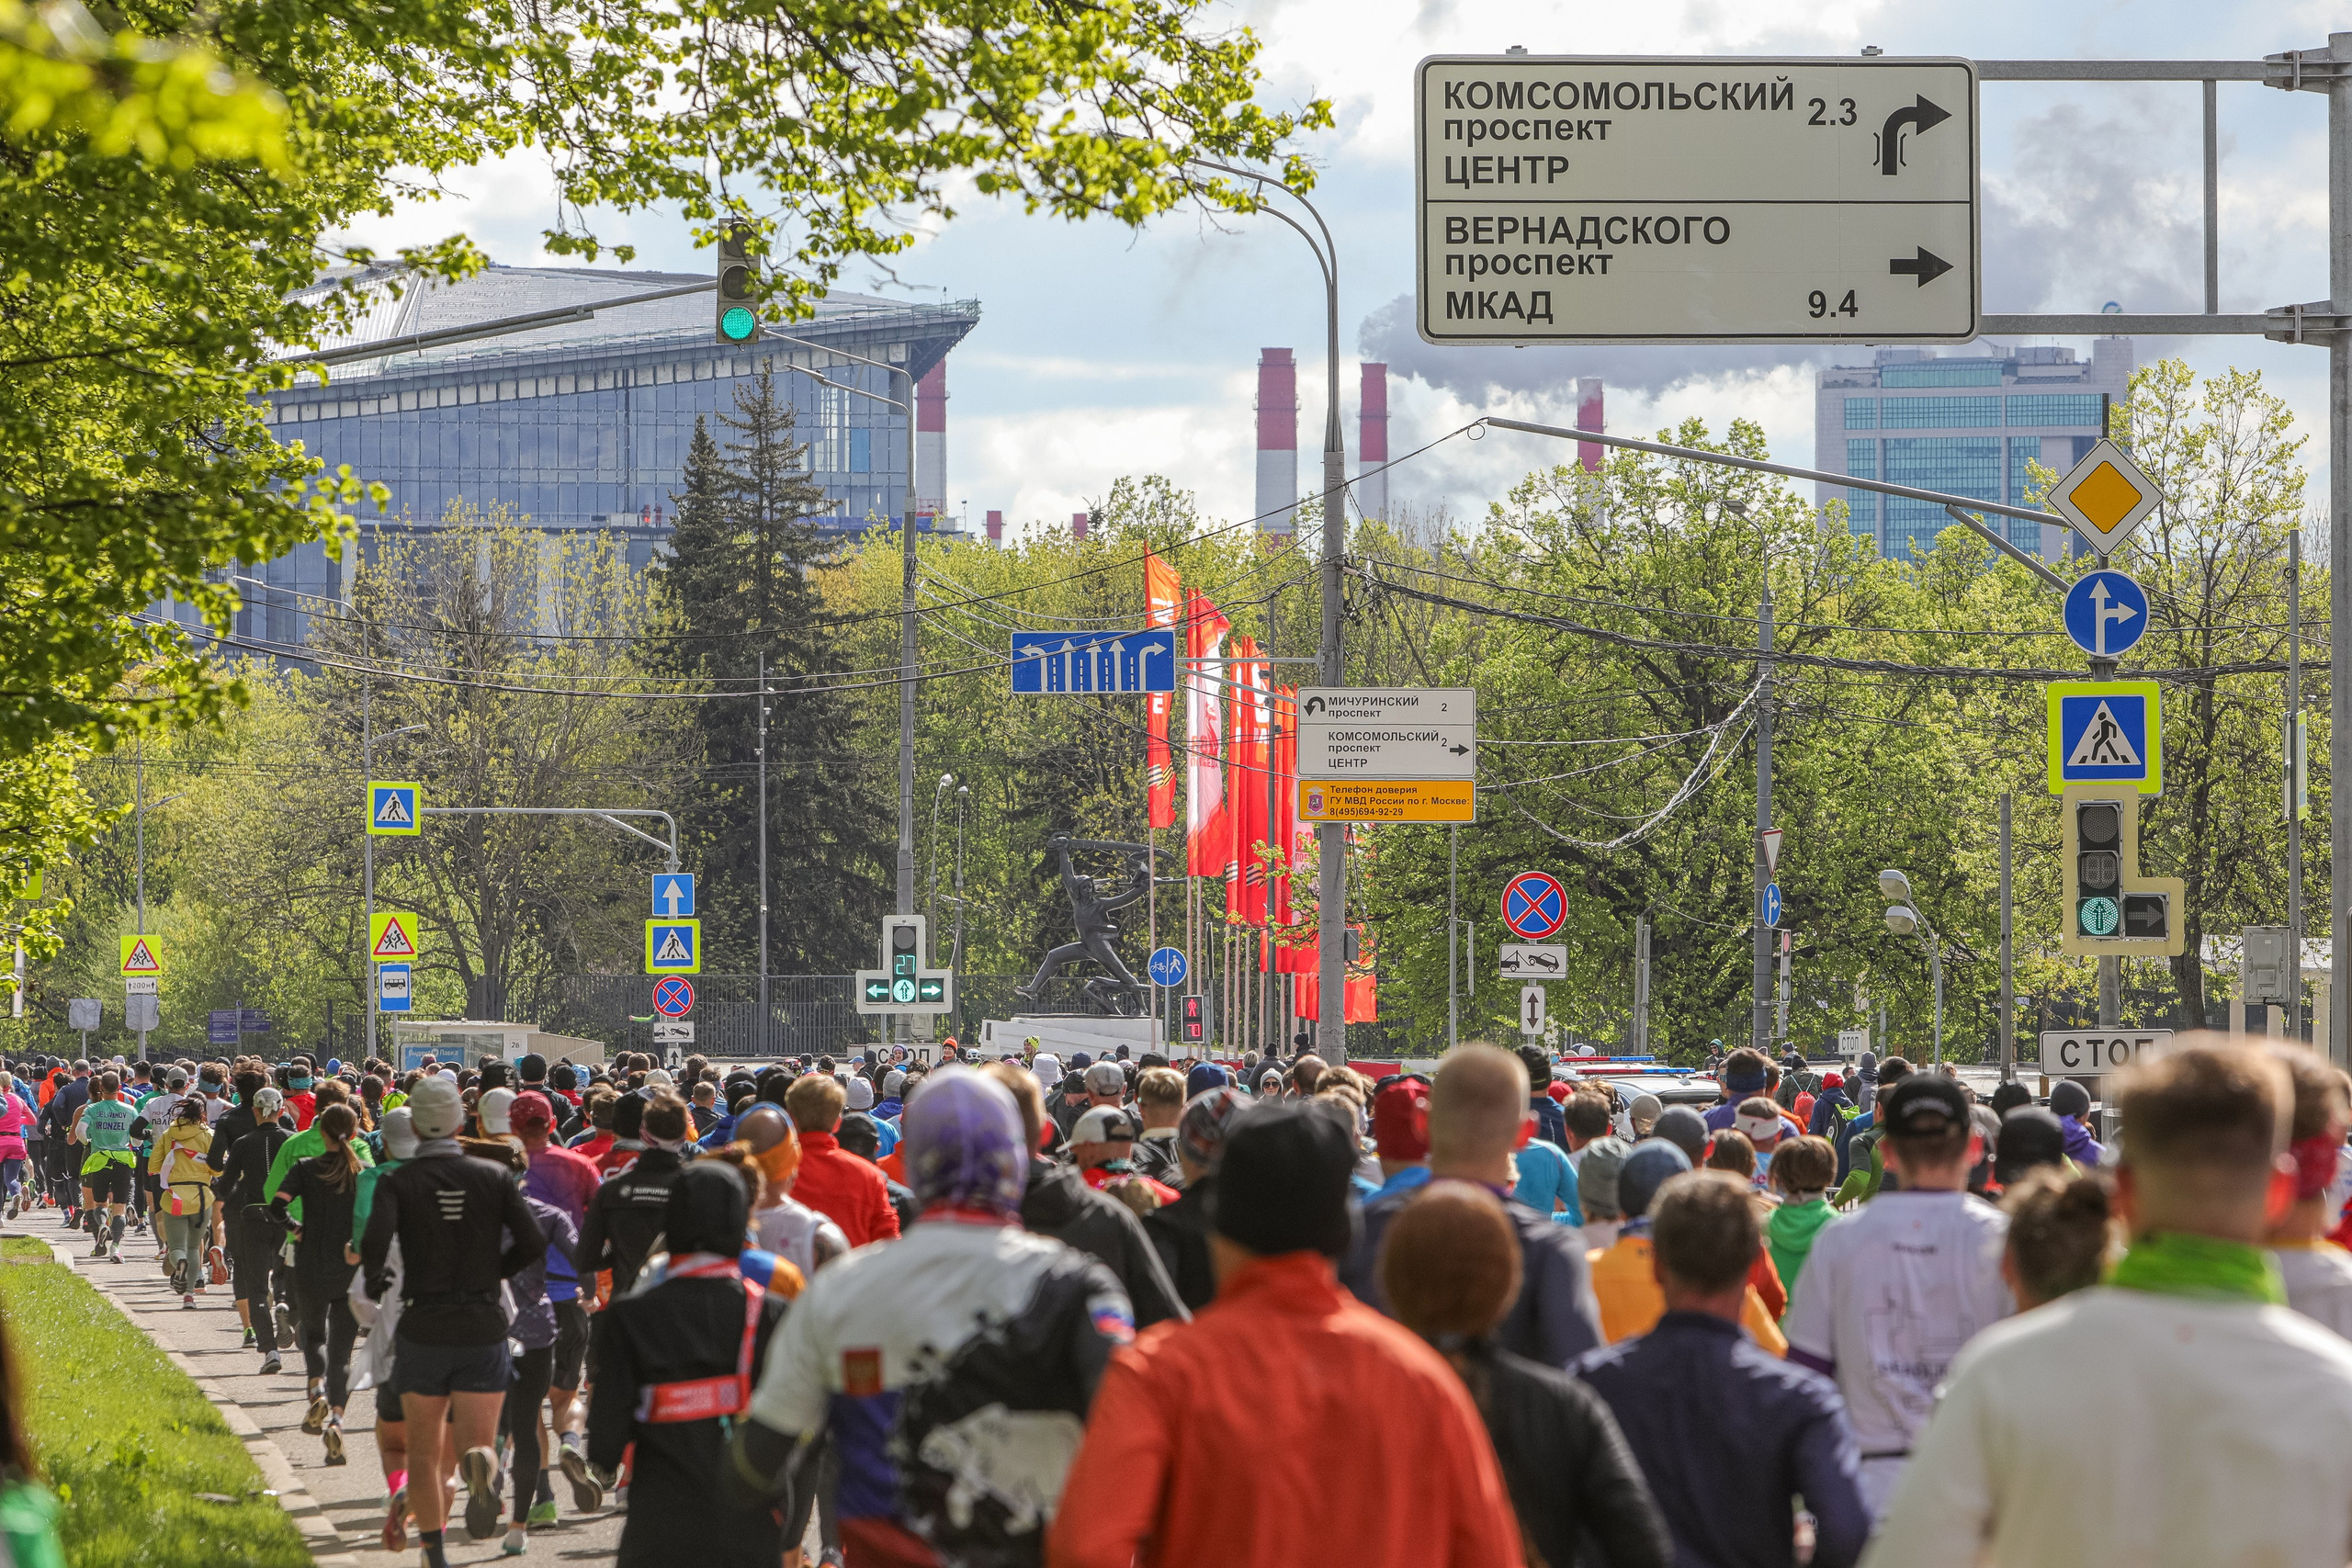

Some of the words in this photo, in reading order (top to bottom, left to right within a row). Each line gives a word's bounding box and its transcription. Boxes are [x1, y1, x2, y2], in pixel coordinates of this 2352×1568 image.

[1444, 76, 1794, 111] КОМСОМОЛЬСКИЙ
[1807, 97, 1859, 127] 2.3
[1444, 118, 1612, 147] проспект
[1444, 155, 1570, 189] ЦЕНТР
[1445, 216, 1732, 251] ВЕРНАДСКОГО
[1445, 254, 1613, 282] проспект
[1445, 290, 1555, 325] МКАД
[1807, 289, 1860, 319] 9.4
[1329, 695, 1419, 706] МИЧУРИНСКИЙ
[1441, 703, 1448, 712] 2
[1329, 709, 1381, 718] проспект
[1329, 730, 1439, 741] КОМСОМОЛЬСКИЙ
[1441, 738, 1448, 747] 2
[1329, 744, 1381, 753] проспект
[1329, 759, 1368, 769] ЦЕНТР
[1330, 785, 1374, 795] Телефон
[1375, 786, 1418, 795] доверия
[1329, 796, 1342, 806] ГУ
[1344, 796, 1367, 807] МВД
[1430, 796, 1470, 805] Москве:
[1329, 807, 1404, 816] 8(495)694-92-29
[896, 955, 915, 975] 27
[1841, 1036, 1860, 1051] СТОП
[877, 1047, 930, 1065] СОП
[96, 1122, 126, 1131] IRONZEL
